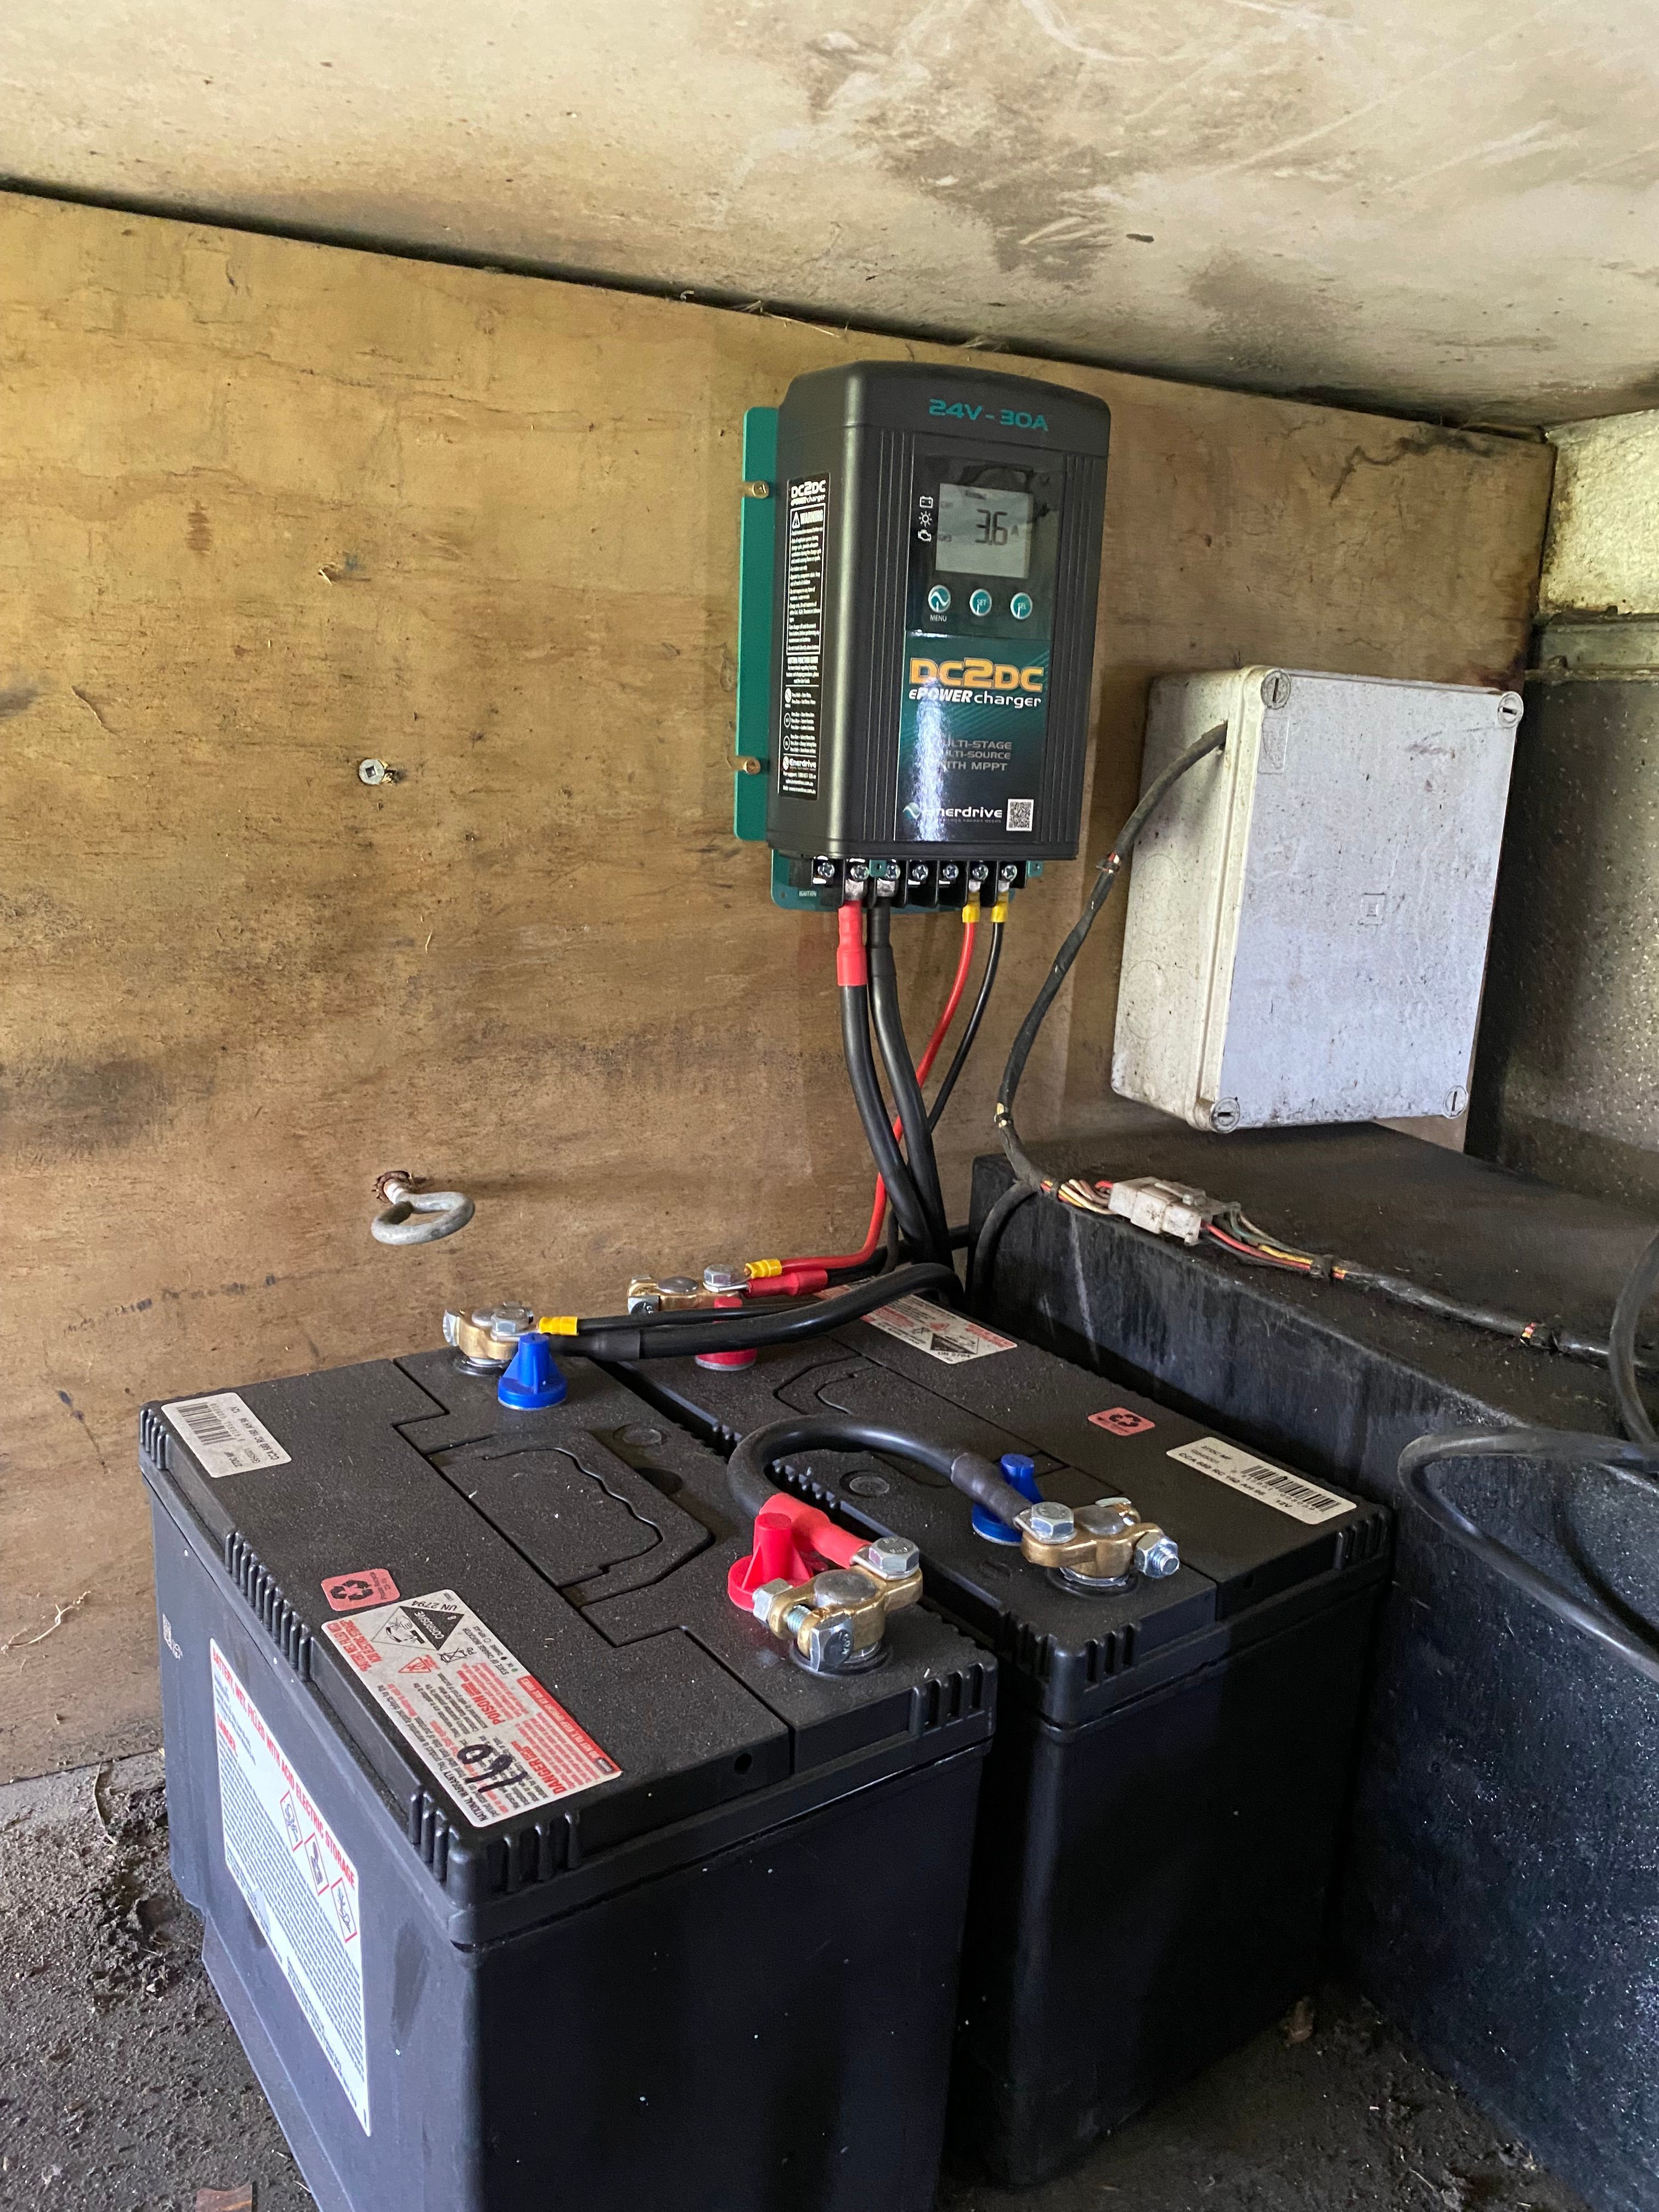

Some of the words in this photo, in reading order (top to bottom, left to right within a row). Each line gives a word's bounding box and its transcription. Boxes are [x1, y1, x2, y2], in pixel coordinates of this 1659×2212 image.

[929, 399, 983, 420] 24V
[1000, 410, 1048, 431] 30A
[791, 480, 826, 499] DC2DC
[800, 509, 823, 525] WARNING
[930, 614, 947, 623] MENU
[909, 657, 1044, 693] DC2DC
[974, 691, 1042, 709] charger
[943, 738, 1012, 751] LTI-STAGE
[943, 750, 1011, 760] LTI-SOURCE
[789, 758, 817, 769] Enerdrive
[971, 761, 1008, 771] MPPT
[935, 806, 1003, 819] nerdrive
[241, 1421, 255, 1430] AH
[252, 1435, 266, 1443] RC
[264, 1449, 280, 1460] CCA
[1176, 1452, 1199, 1463] CCA
[1210, 1468, 1227, 1476] RC
[1273, 1499, 1294, 1509] 12V
[411, 1600, 439, 1609] 2794
[414, 1611, 444, 1639] CORROSIVE
[466, 1647, 478, 1655] Pb
[493, 1662, 510, 1675] STATE
[470, 1694, 506, 1725] POISON
[579, 1741, 594, 1752] NOT
[526, 1757, 567, 1795] DANGER
[441, 1769, 470, 1798] WARRANTY
[247, 1700, 265, 1743] FILLED
[266, 1731, 280, 1768] WITH
[280, 1756, 295, 1793] ACID
[295, 1779, 324, 1842] ELECTRIC
[324, 1827, 355, 1892] STORAGE
[462, 1796, 489, 1822] NATIONAL
